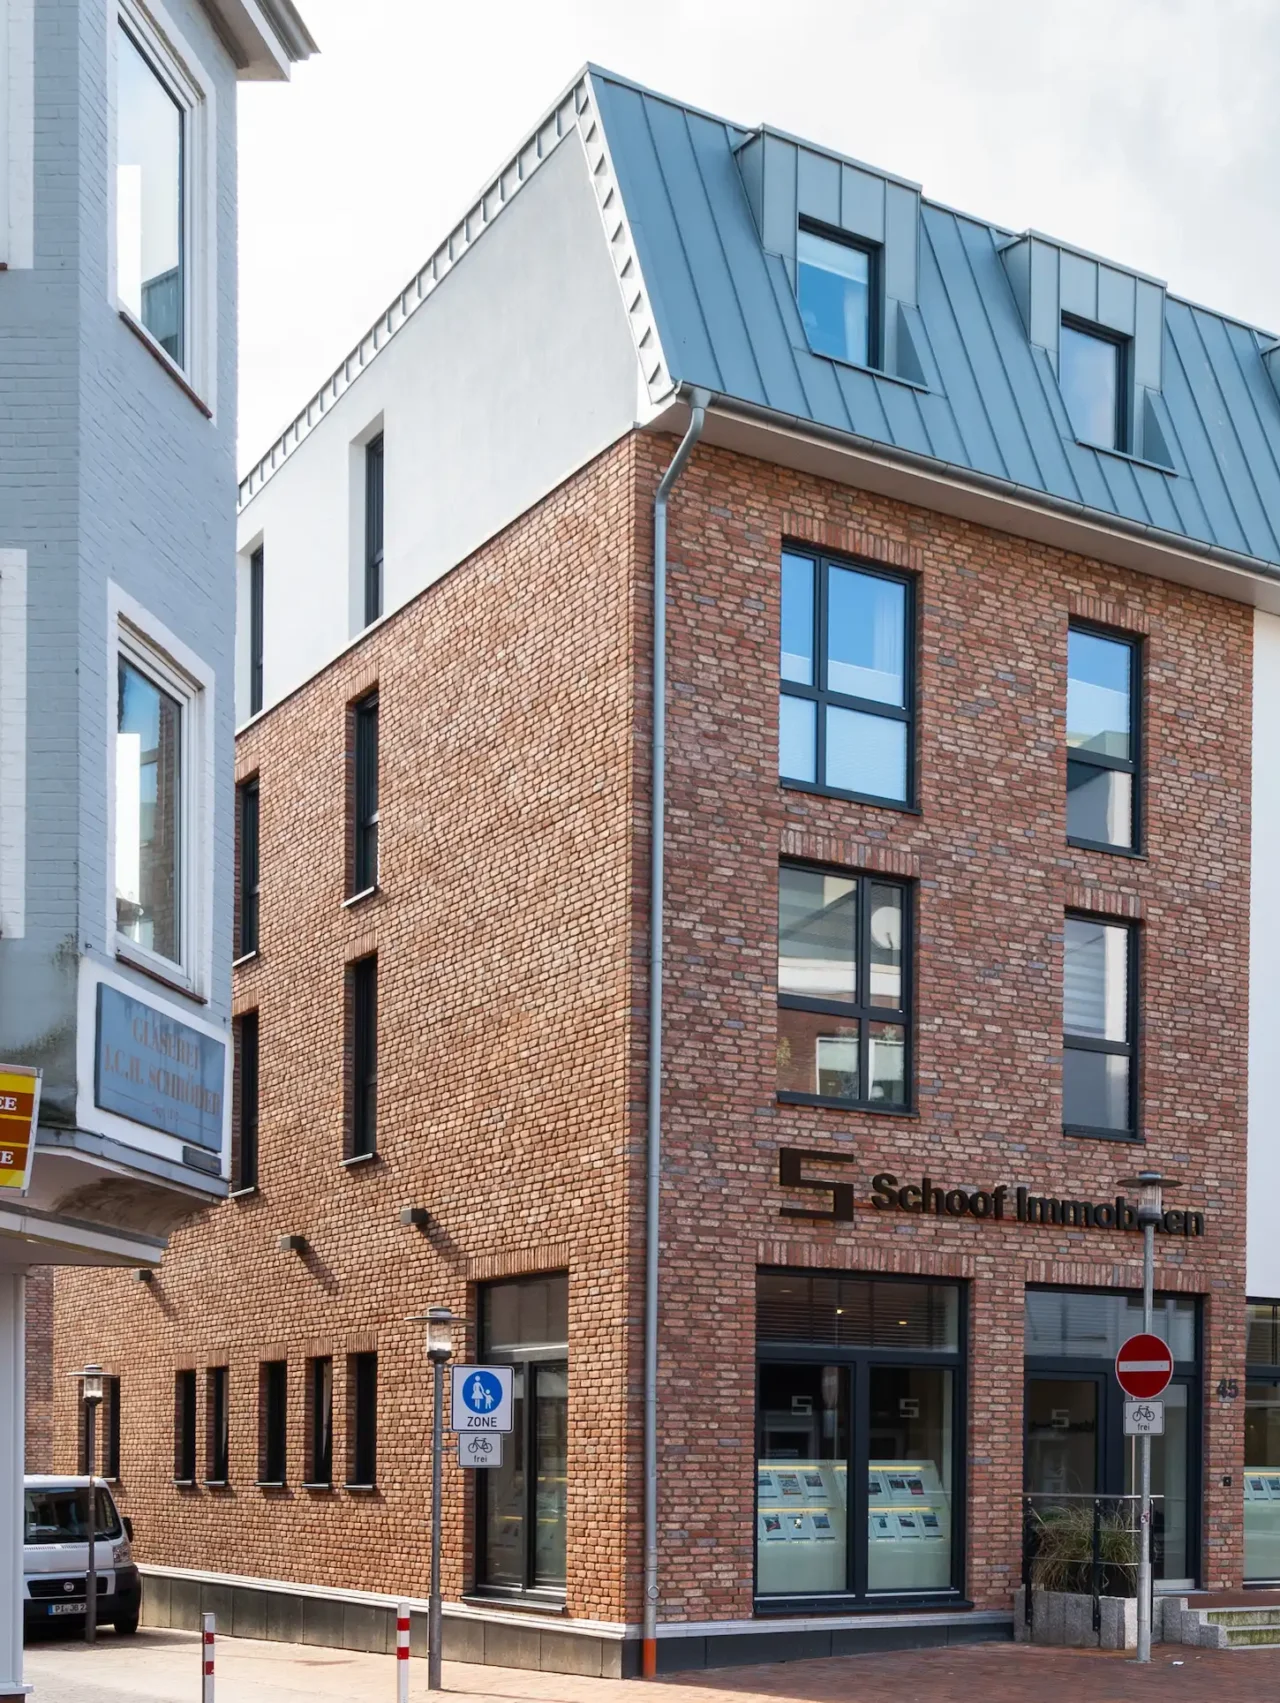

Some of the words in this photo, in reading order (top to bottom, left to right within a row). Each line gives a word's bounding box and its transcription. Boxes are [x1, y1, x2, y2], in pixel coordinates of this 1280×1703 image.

[871, 1173, 1007, 1219] Schoof
[1217, 1378, 1240, 1399] 45
[467, 1416, 497, 1427] ZONE
[1137, 1422, 1150, 1431] frei
[473, 1455, 488, 1463] frei
